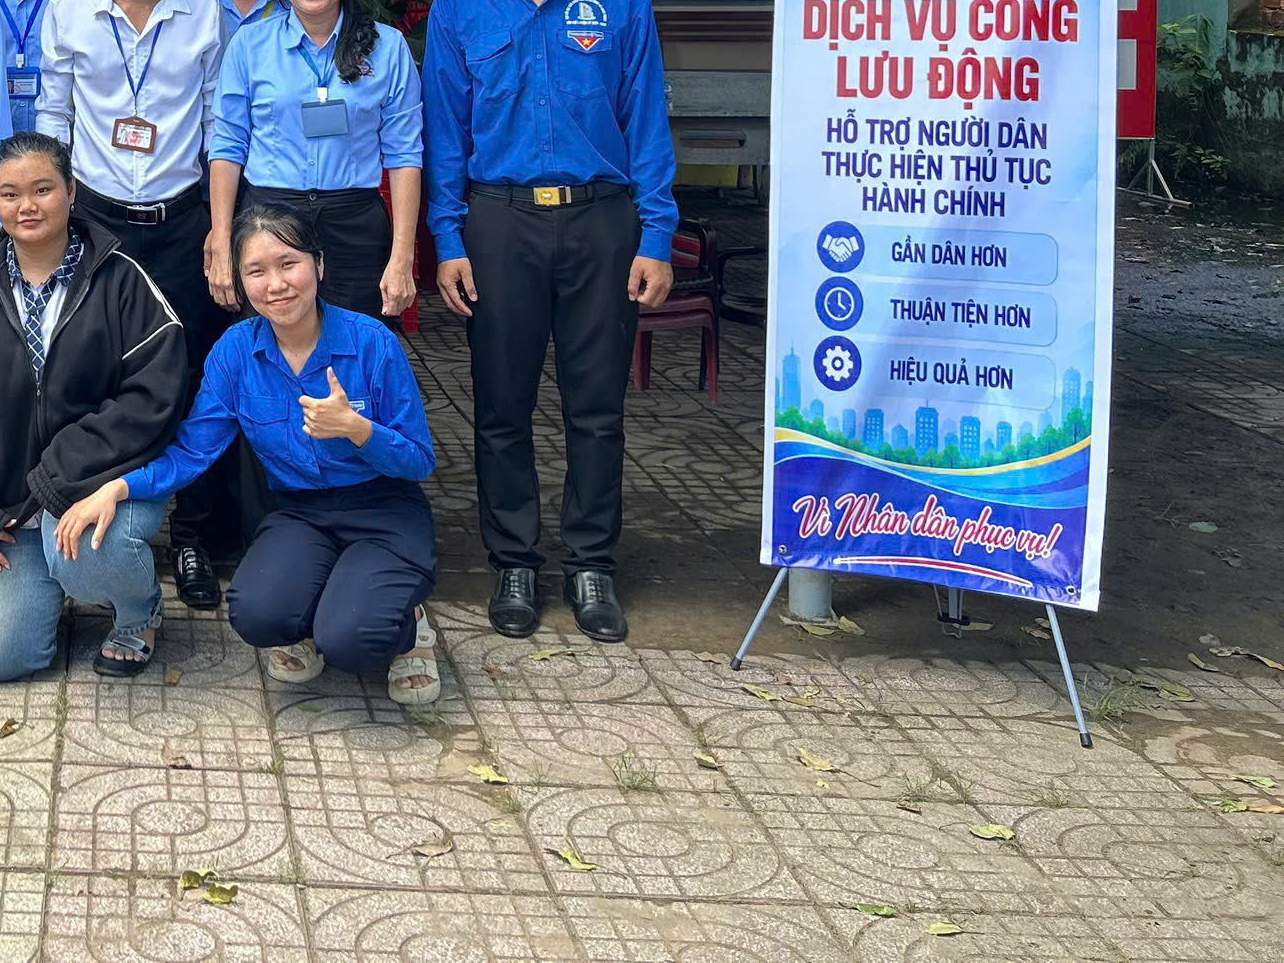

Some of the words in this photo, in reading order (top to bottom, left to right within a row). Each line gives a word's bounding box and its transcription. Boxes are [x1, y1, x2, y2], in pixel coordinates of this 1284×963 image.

[838, 51, 913, 99] LƯU
[928, 45, 1040, 109] ĐỘNG
[827, 109, 858, 143] HỖ
[866, 117, 911, 151] TRỢ
[919, 116, 989, 147] NGƯỜI
[998, 117, 1047, 149] DÂN
[822, 149, 882, 178] THỰC
[890, 147, 943, 185] HIỆN
[951, 149, 997, 182] THỦ
[1004, 157, 1051, 190] TỤC
[862, 187, 925, 213] HÀNH
[934, 185, 1005, 217] CHÍNH
[892, 235, 925, 264] GẦN
[932, 240, 965, 265] DÂN
[971, 244, 1006, 267] HƠN
[890, 297, 945, 325] THUẬN
[951, 299, 988, 328] TIỆN
[995, 304, 1030, 328] HƠN
[890, 357, 927, 385] HIỆU
[934, 358, 969, 385] QUẢ
[976, 365, 1013, 390] HƠN
[793, 495, 831, 539] Vì
[835, 493, 911, 539] Nhân
[917, 494, 958, 538] dân
[957, 507, 1015, 556] phục
[1017, 523, 1063, 560] vụ!
